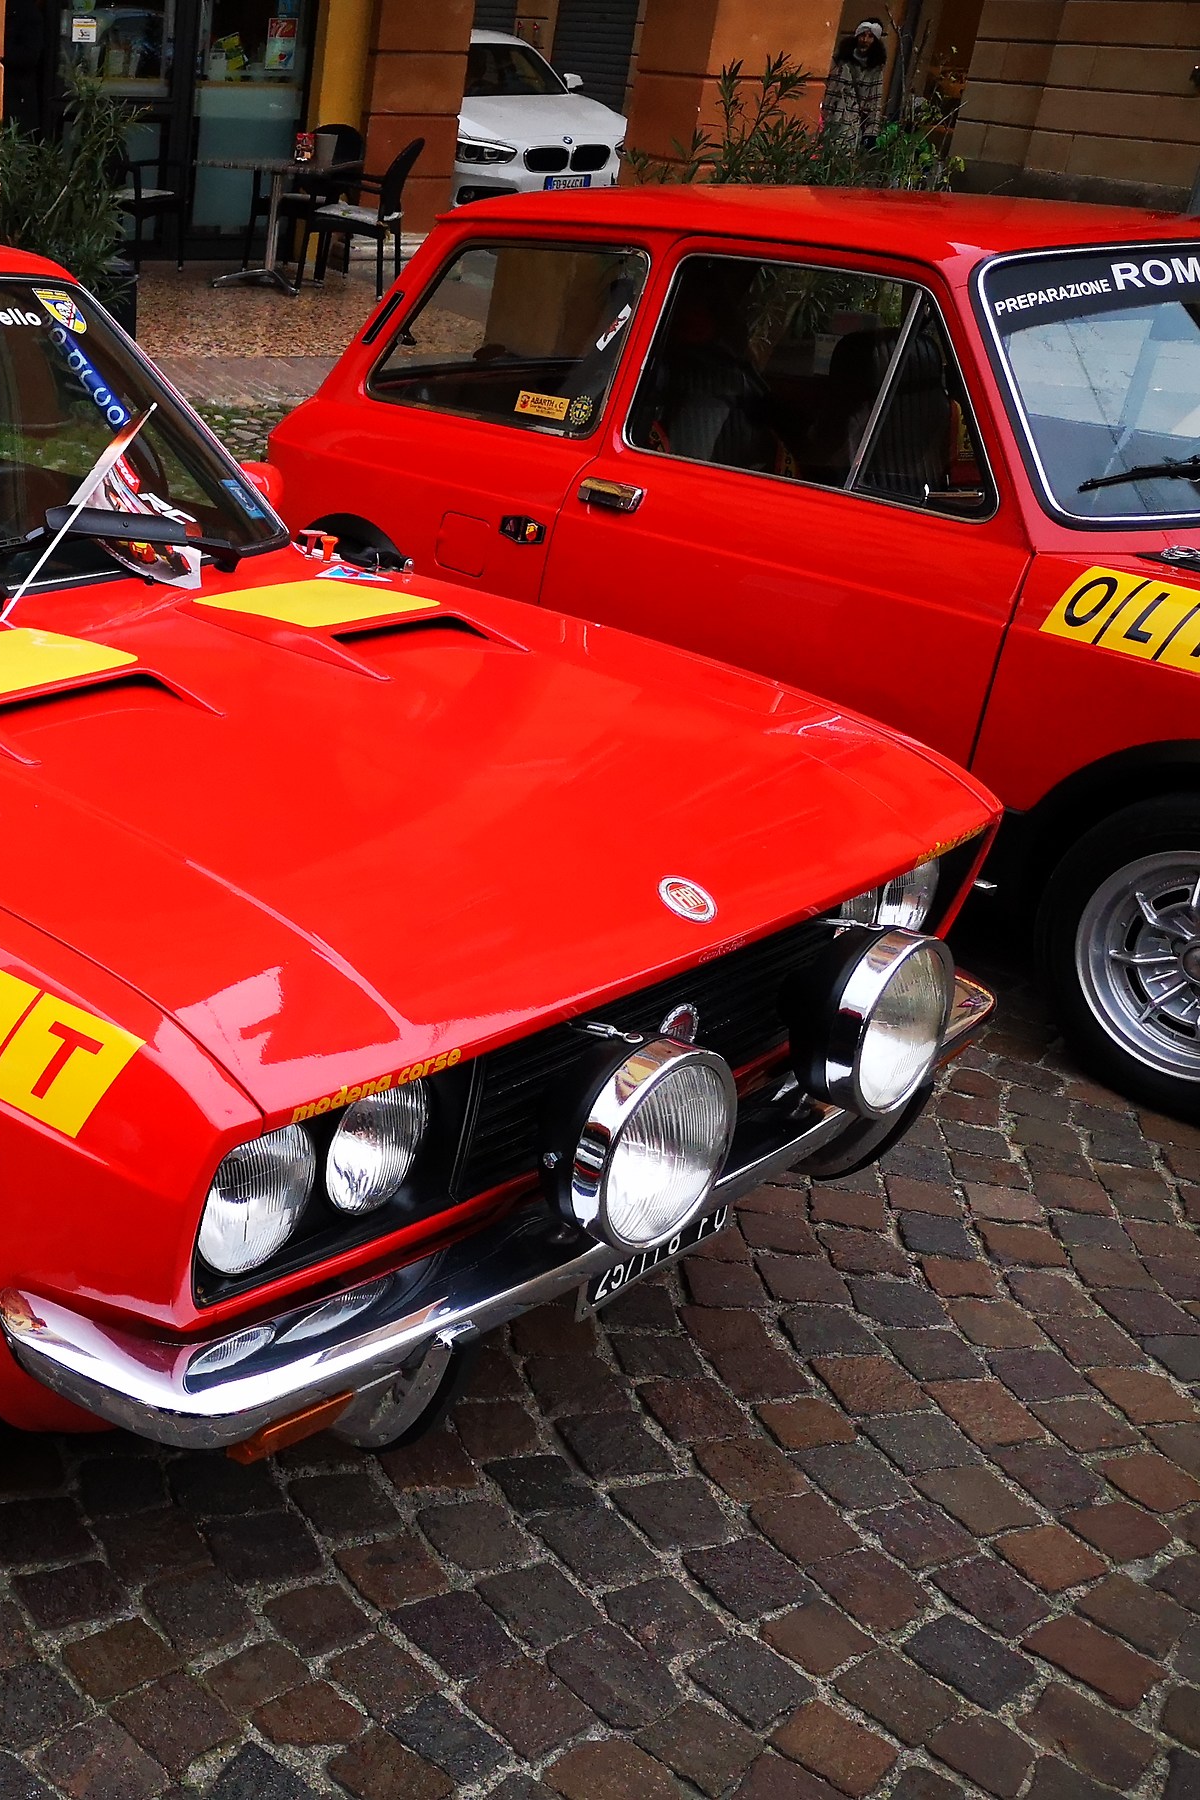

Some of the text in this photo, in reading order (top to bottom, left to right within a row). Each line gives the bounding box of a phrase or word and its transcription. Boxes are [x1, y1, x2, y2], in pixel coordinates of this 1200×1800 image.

[994, 278, 1112, 316] PREPARAZIONE
[531, 396, 555, 407] ABARTH
[669, 886, 706, 910] FIAT
[291, 1048, 462, 1124] modena corse
